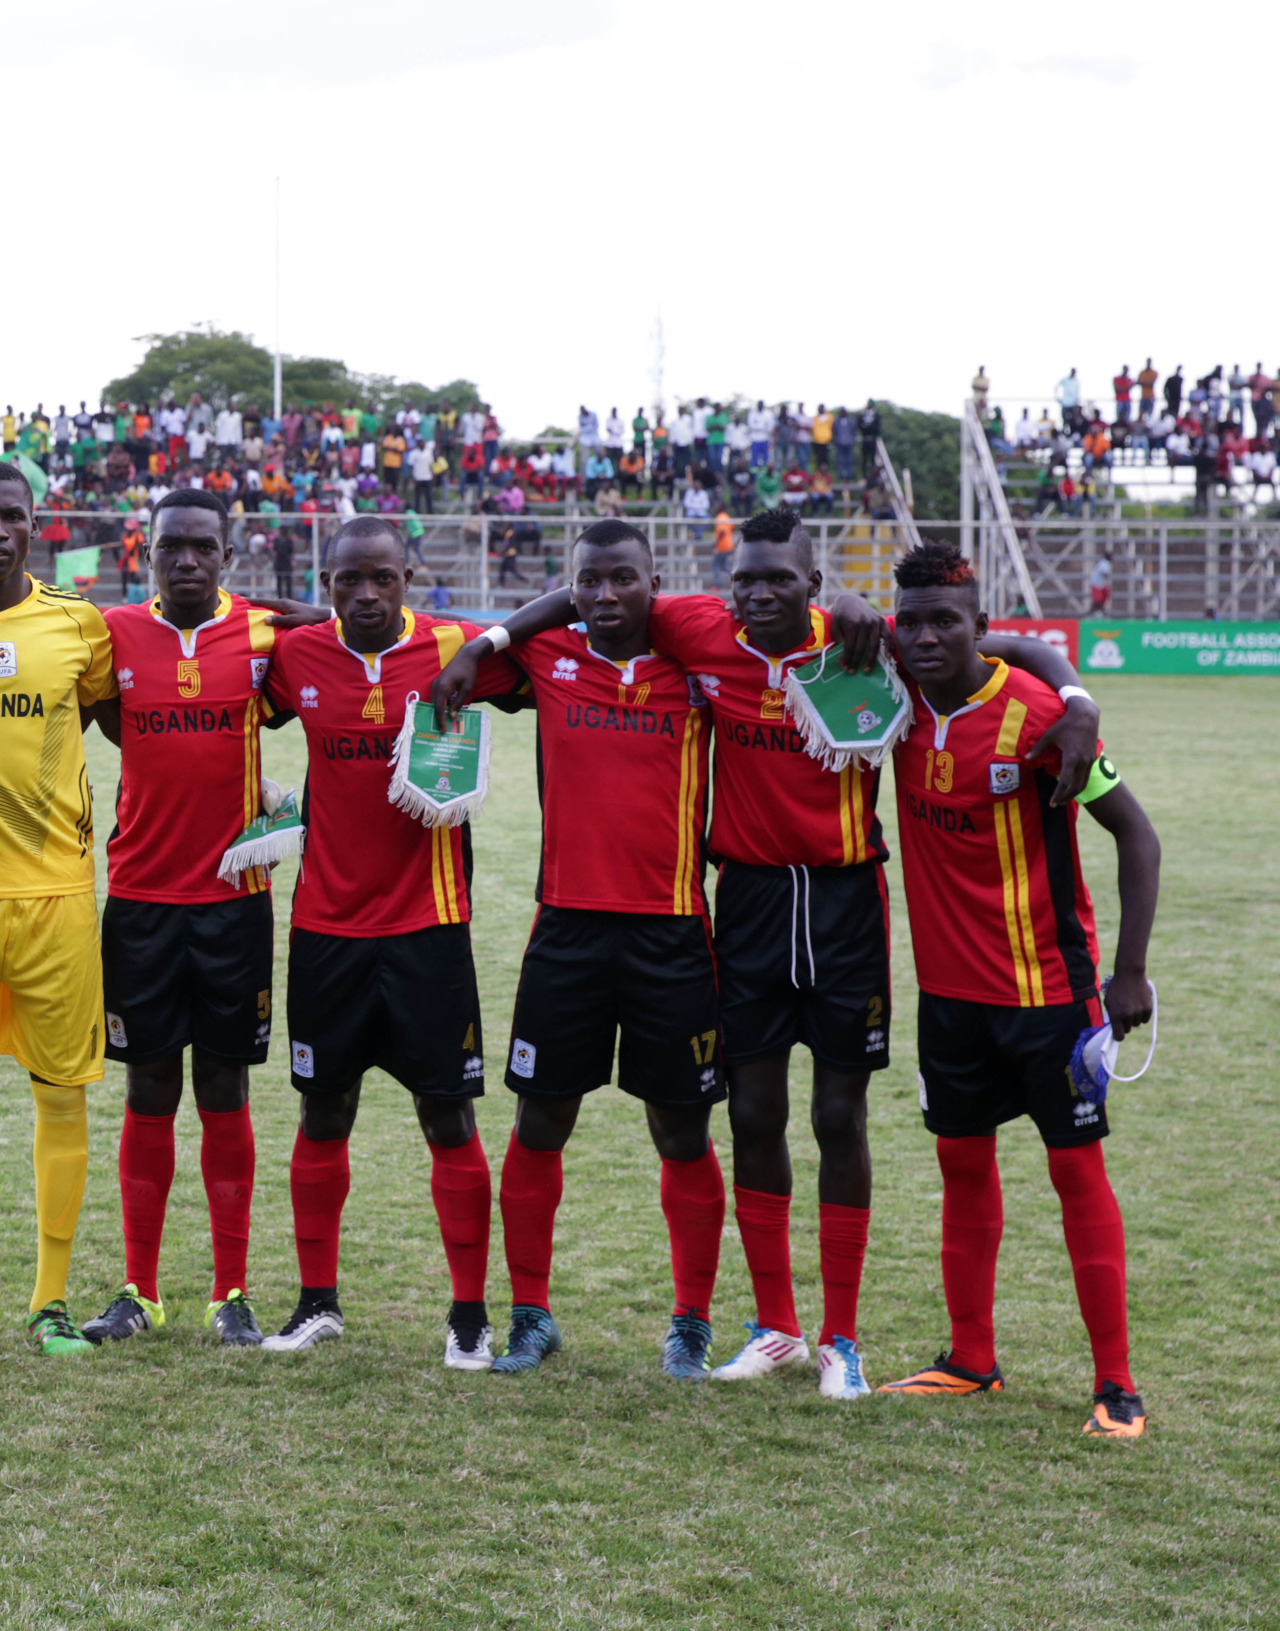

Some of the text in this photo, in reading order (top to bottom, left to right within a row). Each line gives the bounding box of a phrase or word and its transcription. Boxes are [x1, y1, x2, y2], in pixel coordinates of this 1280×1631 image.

[1141, 631, 1229, 649] FOOTBALL
[1196, 649, 1280, 667] OF ZAMBI
[177, 660, 201, 698] 5
[362, 685, 385, 724] 4
[760, 689, 785, 719] 2
[134, 709, 233, 735] UGANDA
[566, 705, 674, 738] UGANDA
[721, 717, 804, 753] UGAND
[322, 736, 397, 761] UGAN
[925, 749, 954, 793] 13
[257, 989, 270, 1020] 5
[866, 995, 882, 1027] 2
[462, 1022, 475, 1052] 4
[689, 1029, 717, 1065] 17
